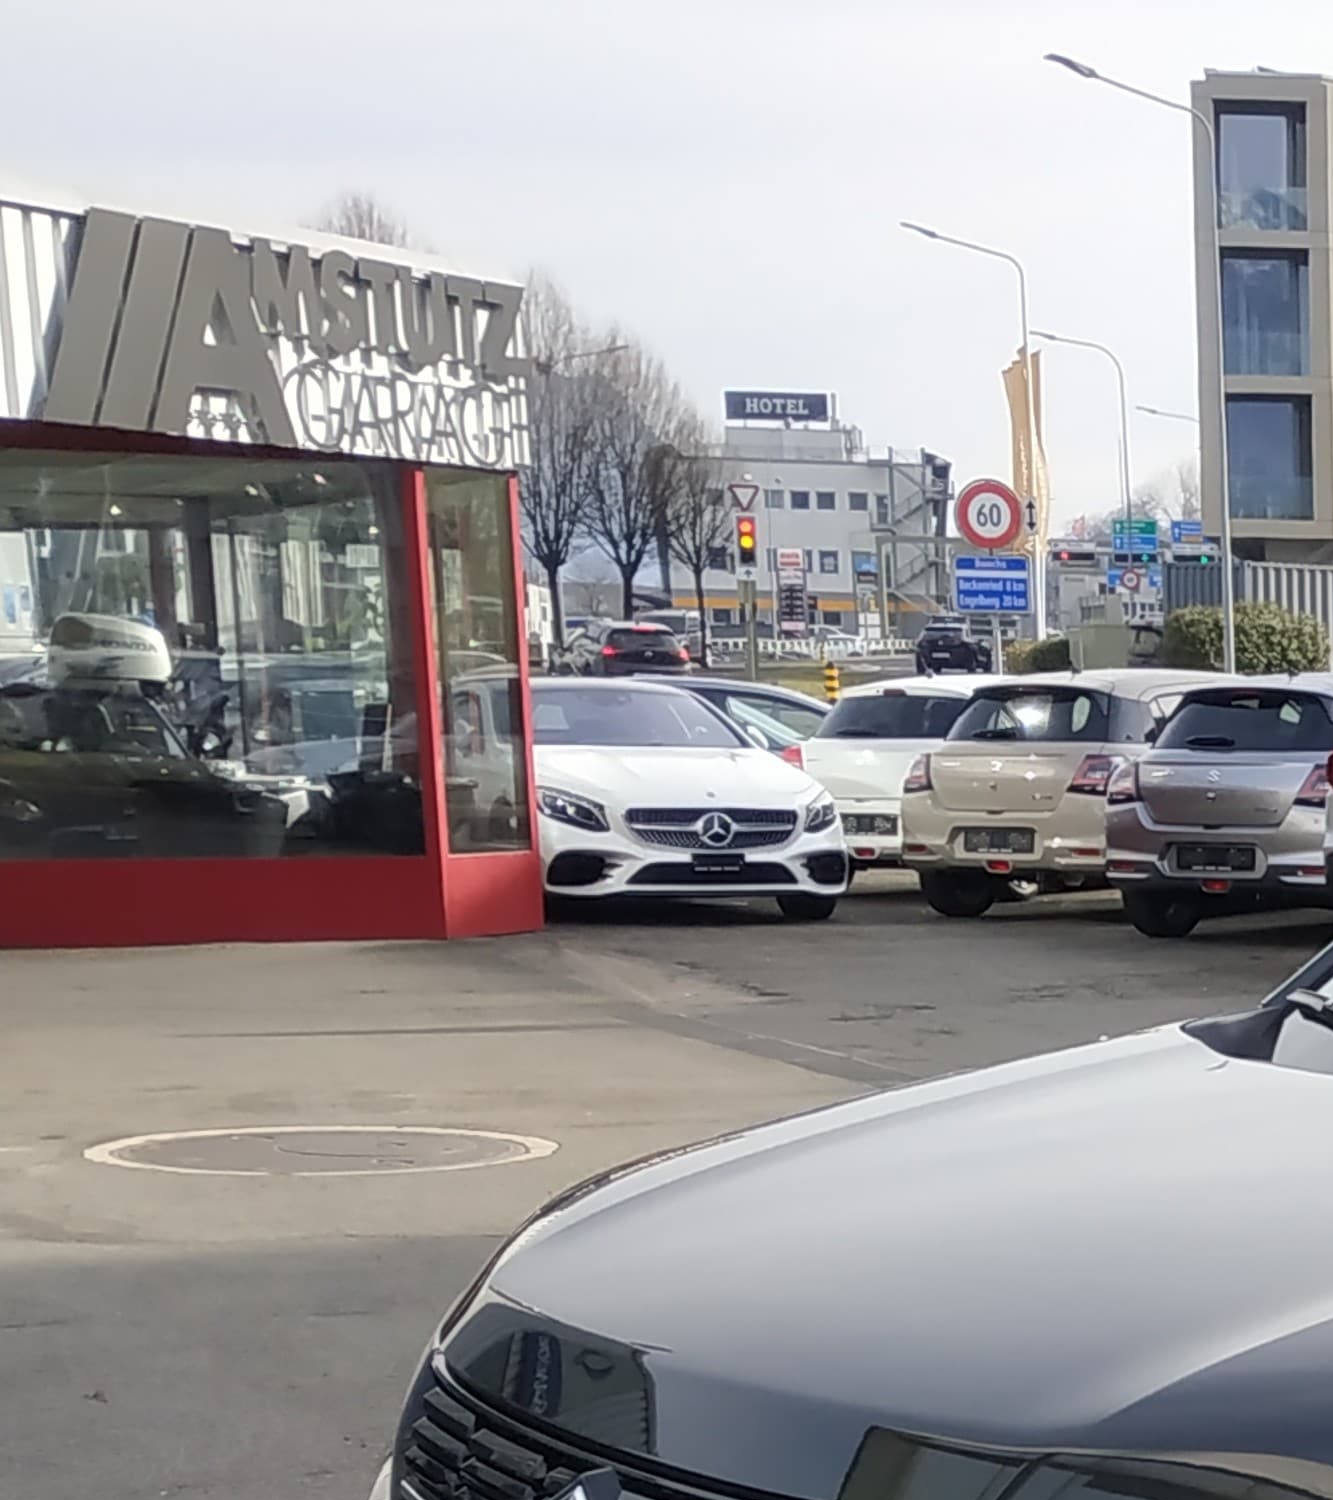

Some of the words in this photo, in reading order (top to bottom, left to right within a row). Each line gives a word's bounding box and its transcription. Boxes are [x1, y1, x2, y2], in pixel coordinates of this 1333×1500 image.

[150, 222, 534, 448] AMSTUTZ
[744, 397, 809, 415] HOTEL
[976, 503, 1002, 527] 60
[1013, 581, 1026, 592] km
[1014, 595, 1026, 608] km
